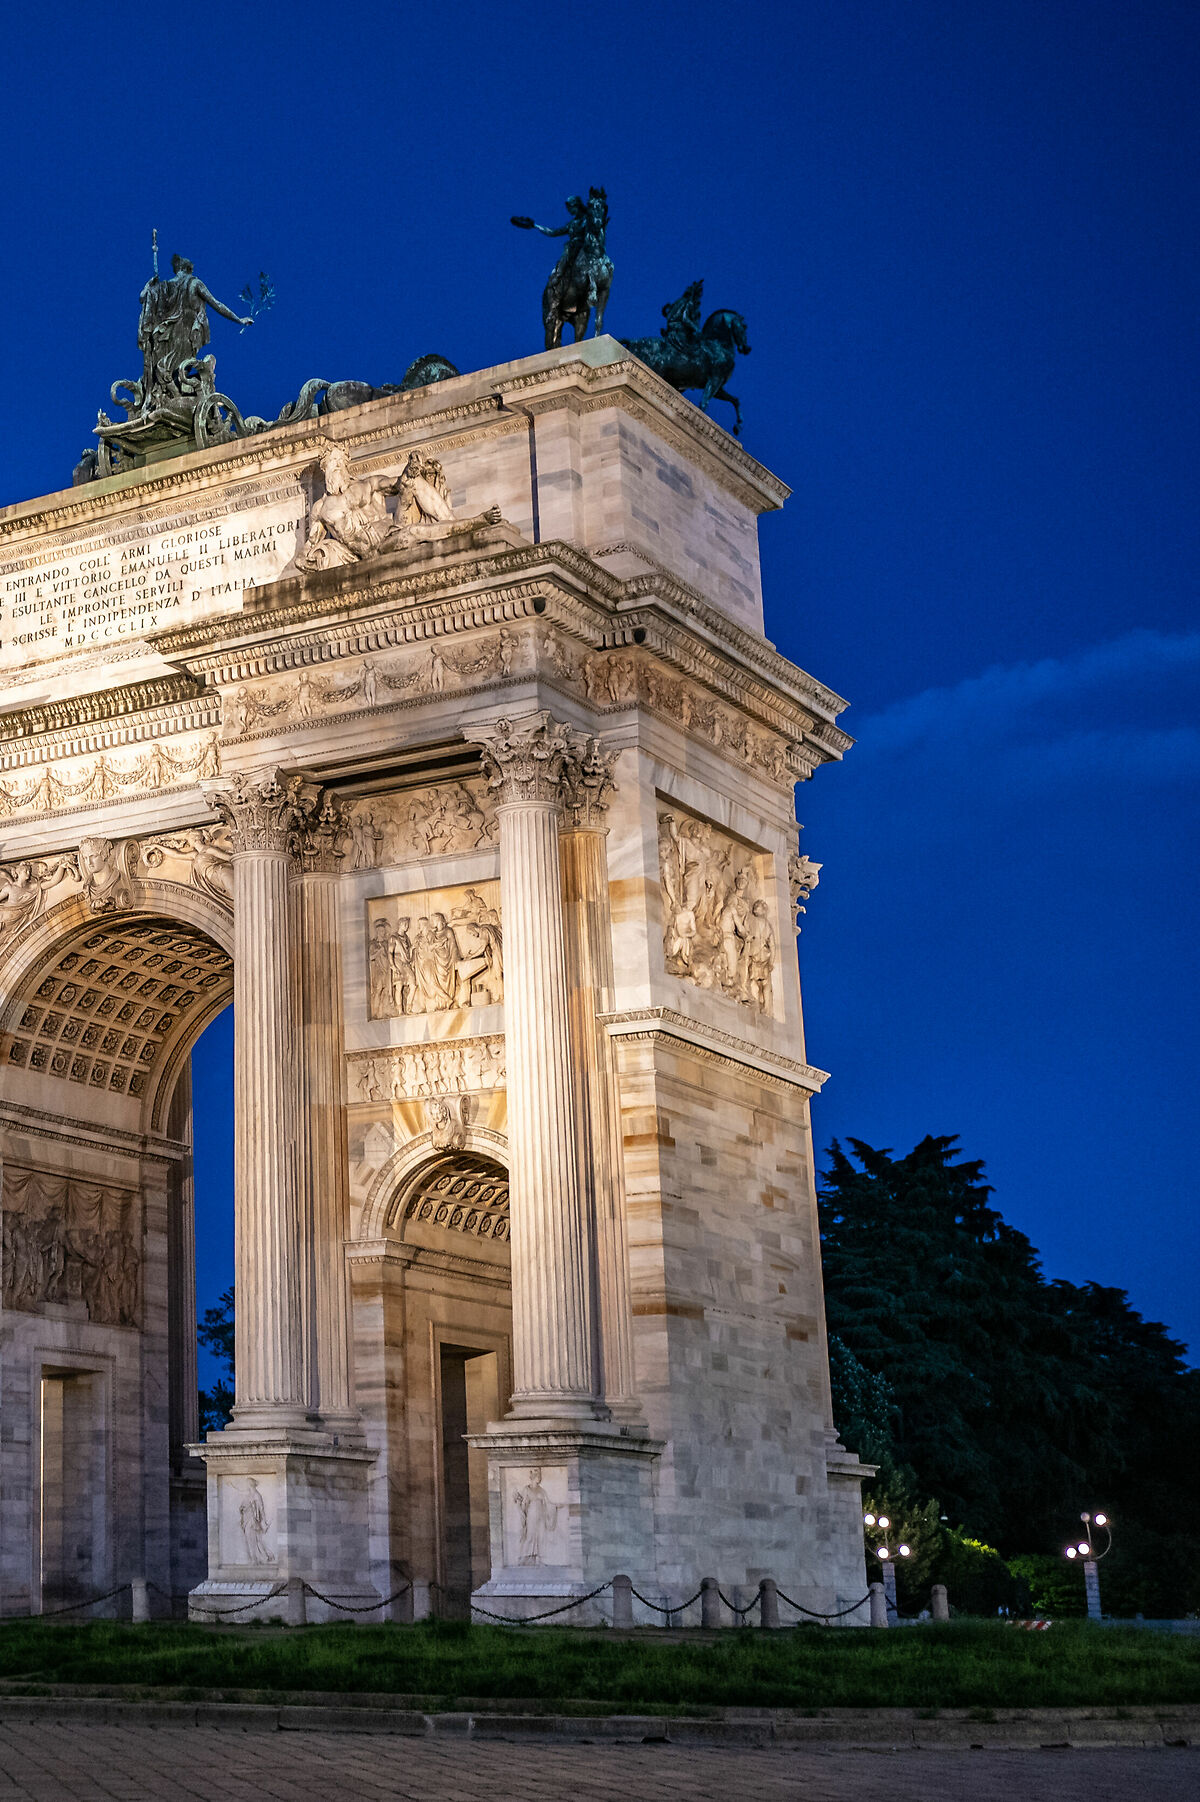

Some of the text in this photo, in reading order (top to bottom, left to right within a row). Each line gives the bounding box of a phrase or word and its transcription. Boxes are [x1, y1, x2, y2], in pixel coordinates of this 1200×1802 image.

[6, 567, 70, 592] ENTRANDO
[120, 544, 151, 562] ARMI
[161, 525, 222, 550] GLORIOSE
[12, 593, 77, 619] ESULTANTE
[155, 568, 172, 582] DA
[180, 554, 225, 576] QUESTI
[233, 539, 278, 561] MARMI
[14, 591, 27, 604] III
[36, 587, 43, 598] E
[52, 569, 112, 593] VITTORIO
[120, 549, 189, 576] EMANUELE
[199, 543, 209, 555] II
[218, 518, 301, 550] LIBERATORI
[12, 626, 58, 647] SCRISSE
[83, 595, 181, 629] INDIPENDENZA
[211, 576, 256, 597] ITALIA
[39, 579, 184, 626] LE IMPRONTE SERVILI
